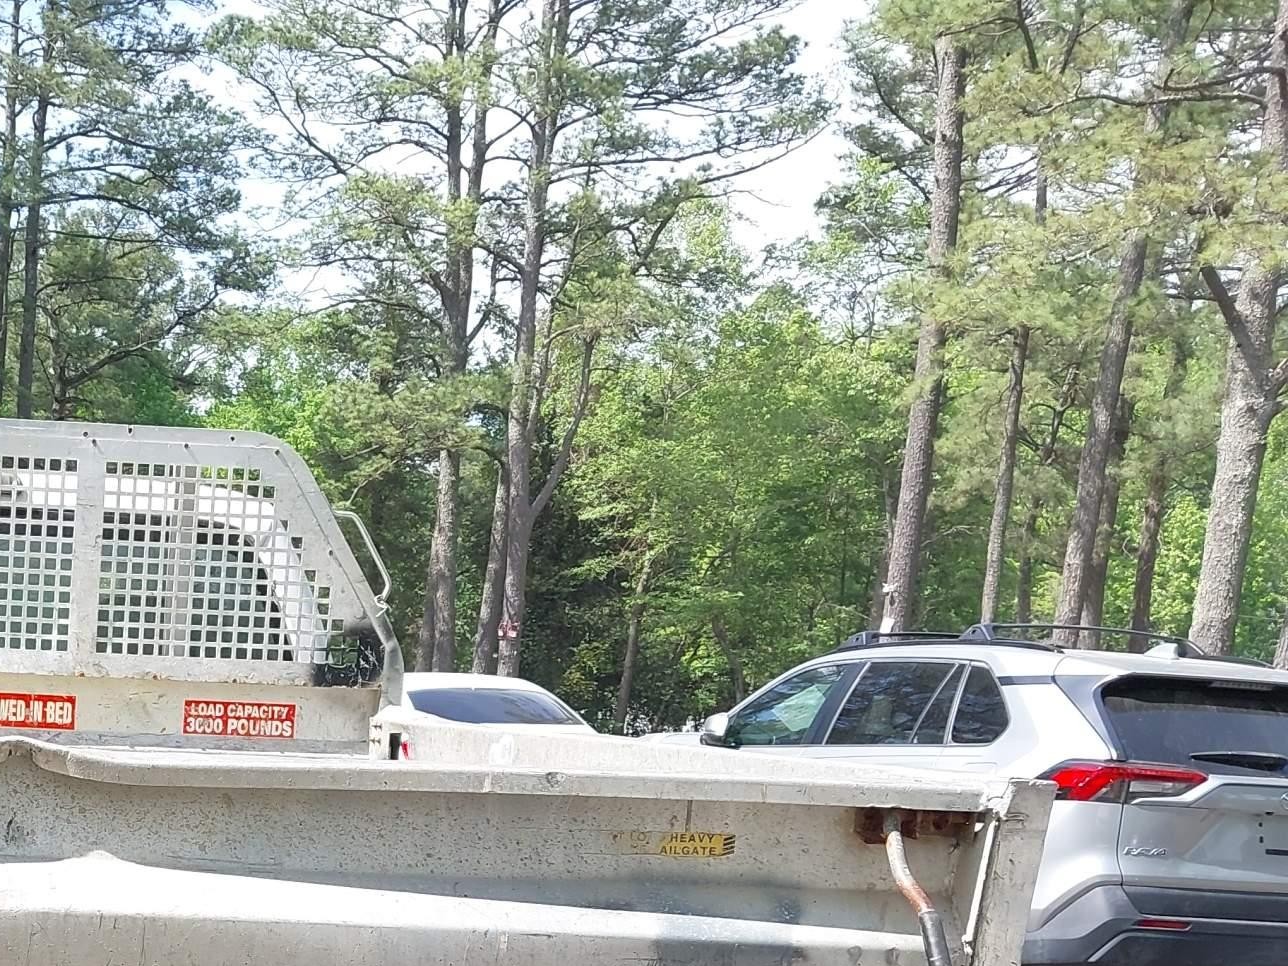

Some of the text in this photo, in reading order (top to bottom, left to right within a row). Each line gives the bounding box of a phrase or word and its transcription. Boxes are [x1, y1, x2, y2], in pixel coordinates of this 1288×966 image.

[28, 699, 43, 723] IN
[45, 701, 73, 725] BED
[189, 702, 289, 720] LOAD CAPACITY
[185, 716, 293, 737] 3000 POUNDS
[669, 832, 715, 844] HEAVY
[659, 845, 717, 856] AILGATE
